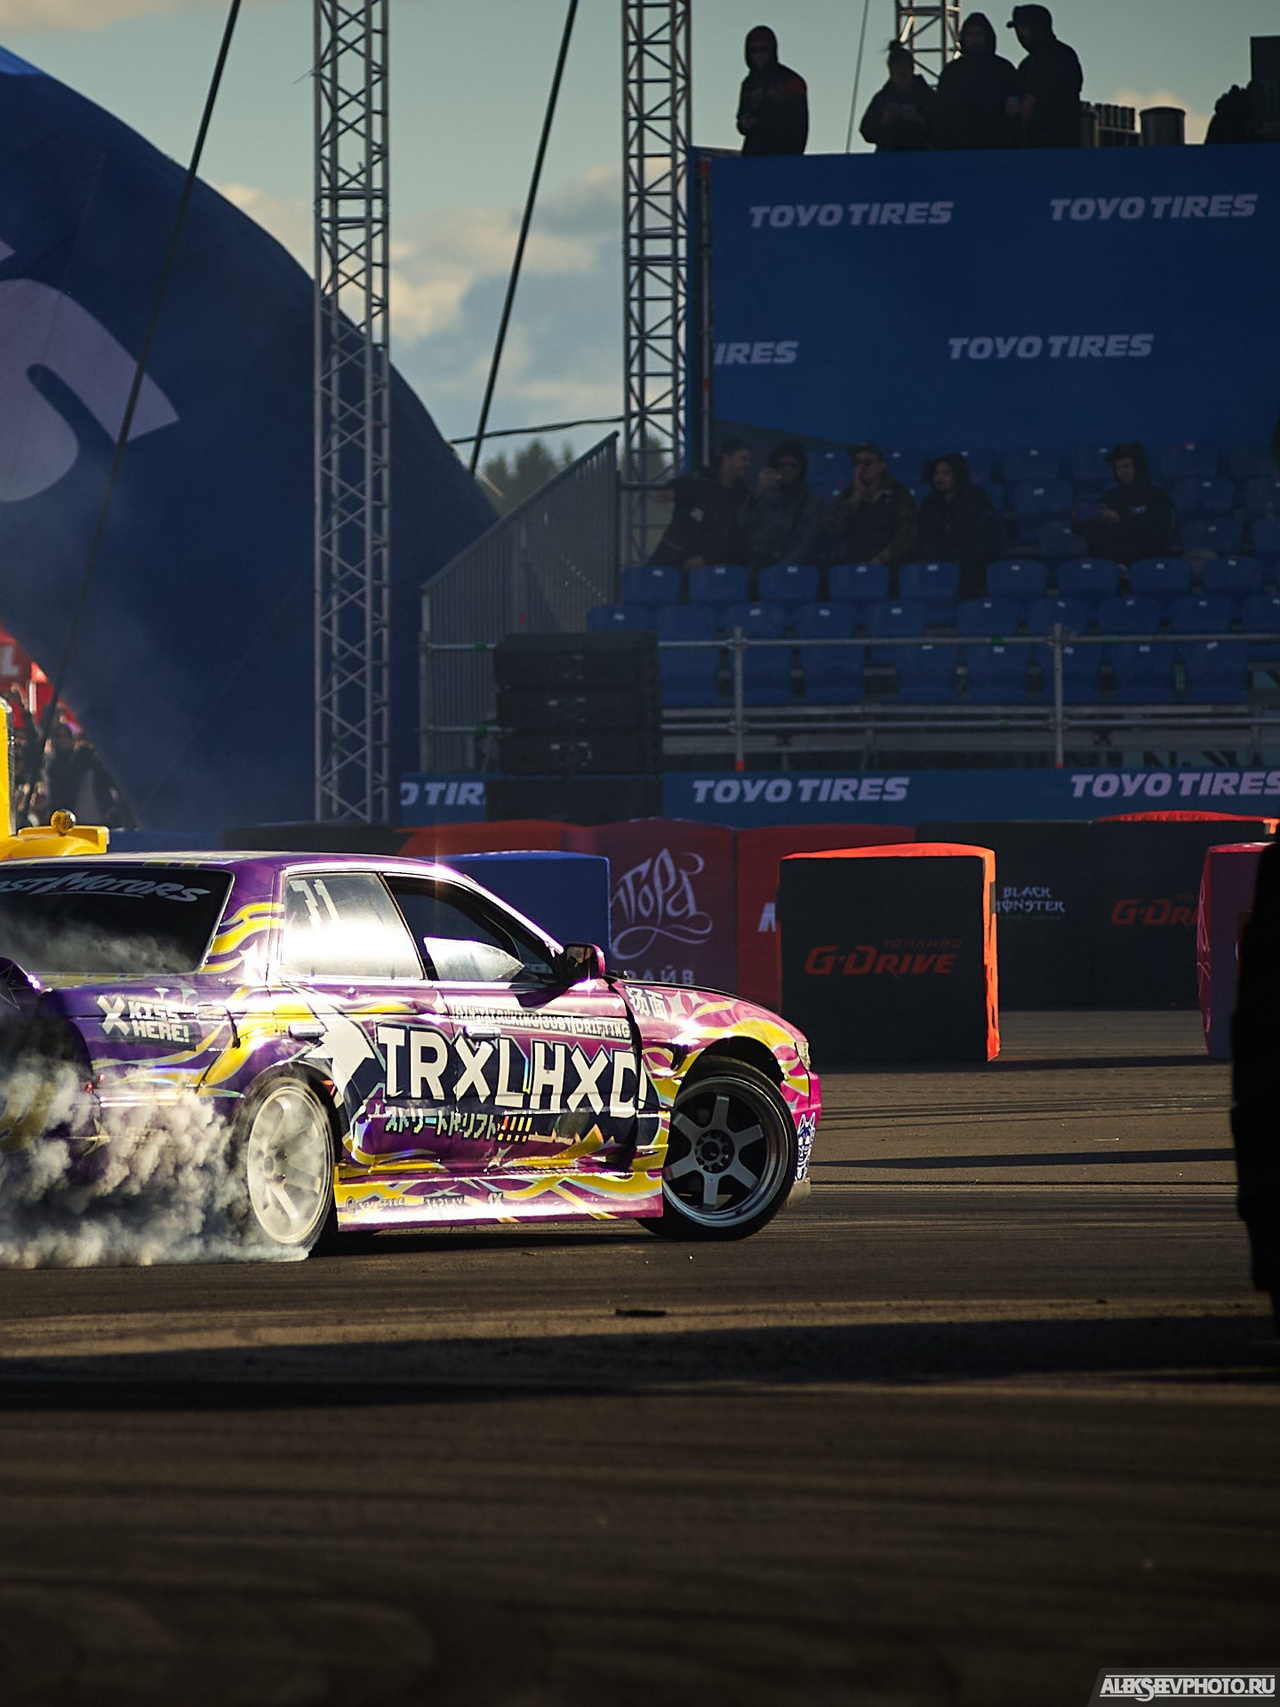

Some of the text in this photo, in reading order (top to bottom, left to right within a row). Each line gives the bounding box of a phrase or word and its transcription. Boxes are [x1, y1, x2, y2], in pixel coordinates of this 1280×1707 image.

[749, 201, 954, 228] TOYO TIRES
[1050, 194, 1258, 221] TOYO TIRES
[713, 340, 800, 365] IRES
[948, 333, 1155, 360] TOYO TIRES
[424, 781, 486, 806] TIR
[692, 776, 911, 804] TOYO TIRES
[1070, 771, 1173, 799] TOYO
[1003, 886, 1052, 899] BLACK
[128, 1001, 182, 1023] KISS
[131, 1020, 190, 1043] HERE!
[574, 1018, 630, 1039] DRIFTING
[377, 1025, 648, 1119] TRXLHXD
